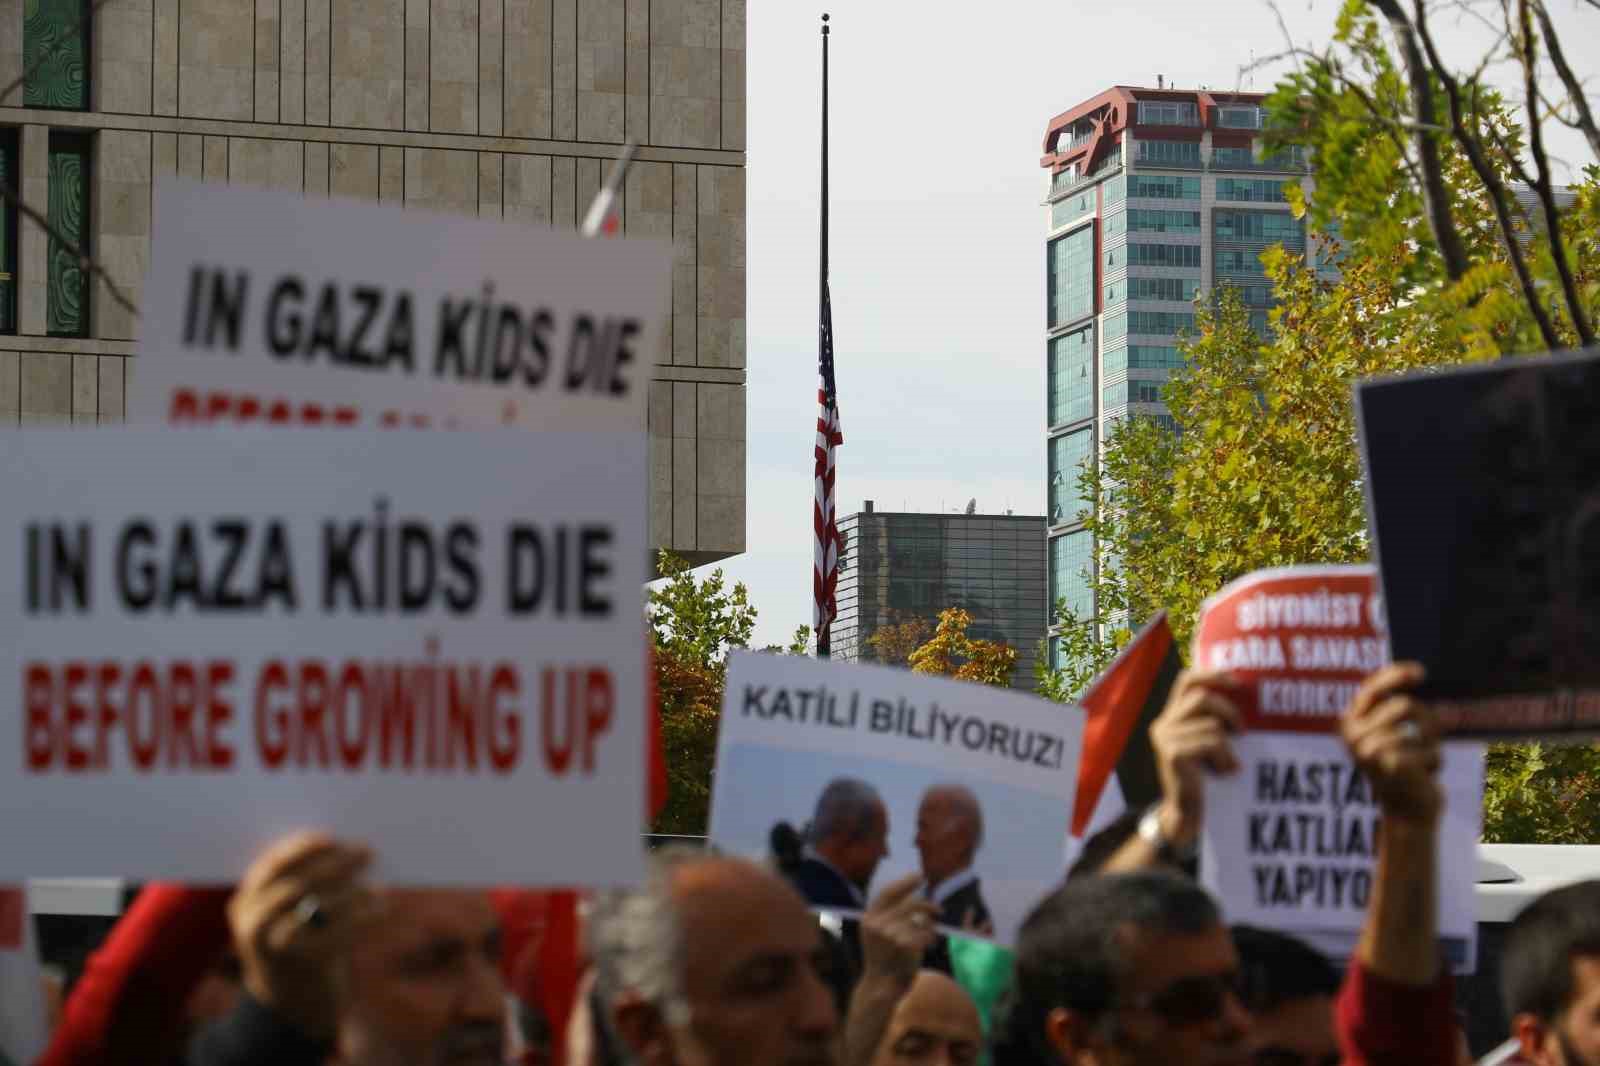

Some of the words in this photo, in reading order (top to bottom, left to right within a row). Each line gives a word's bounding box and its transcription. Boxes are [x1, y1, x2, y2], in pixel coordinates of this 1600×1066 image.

[183, 264, 248, 352] IN
[264, 272, 416, 374] GAZA
[562, 310, 644, 397] DIE
[25, 519, 91, 614] IN
[117, 519, 298, 615] GAZA
[505, 522, 615, 617] DIE
[23, 660, 235, 773] BEFORE
[541, 665, 615, 774] UP
[740, 683, 861, 730] KATİLİ
[869, 698, 1066, 770] BİLİYORUZ!
[1256, 759, 1376, 805] HASTA
